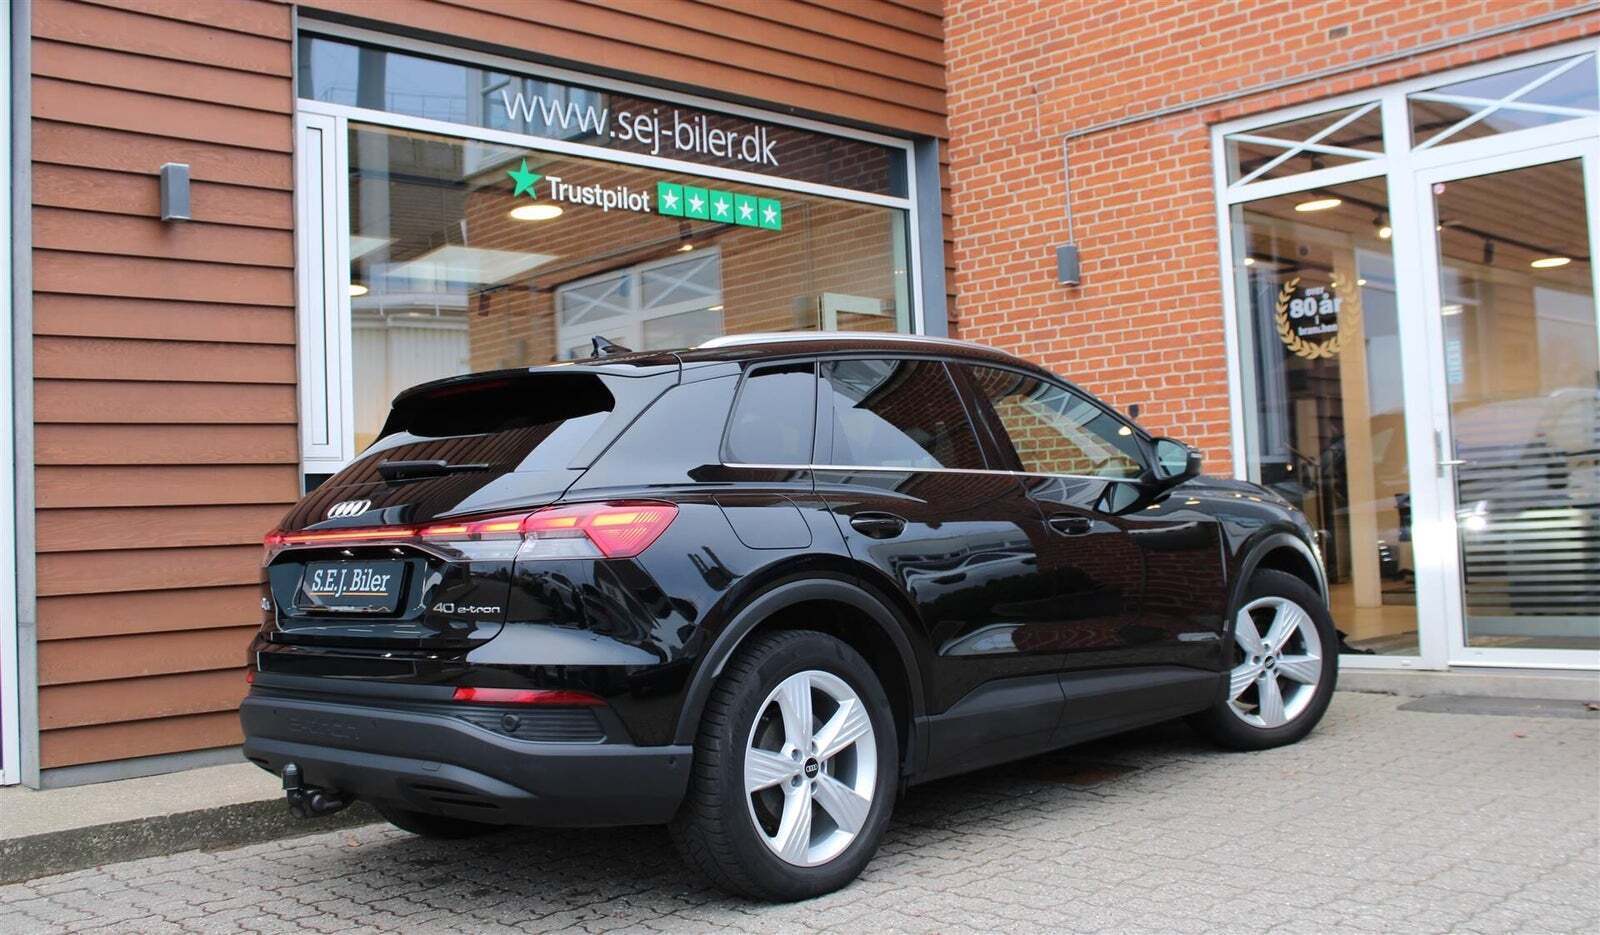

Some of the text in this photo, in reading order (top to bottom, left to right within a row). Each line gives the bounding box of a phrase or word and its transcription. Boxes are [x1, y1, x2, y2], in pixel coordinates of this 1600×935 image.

[501, 89, 780, 167] www.sej-biler.dk
[545, 175, 650, 213] Trustpilot
[1289, 292, 1342, 319] 80 år
[311, 568, 391, 598] S.E.J. Biler
[432, 602, 501, 614] 40 e-tron
